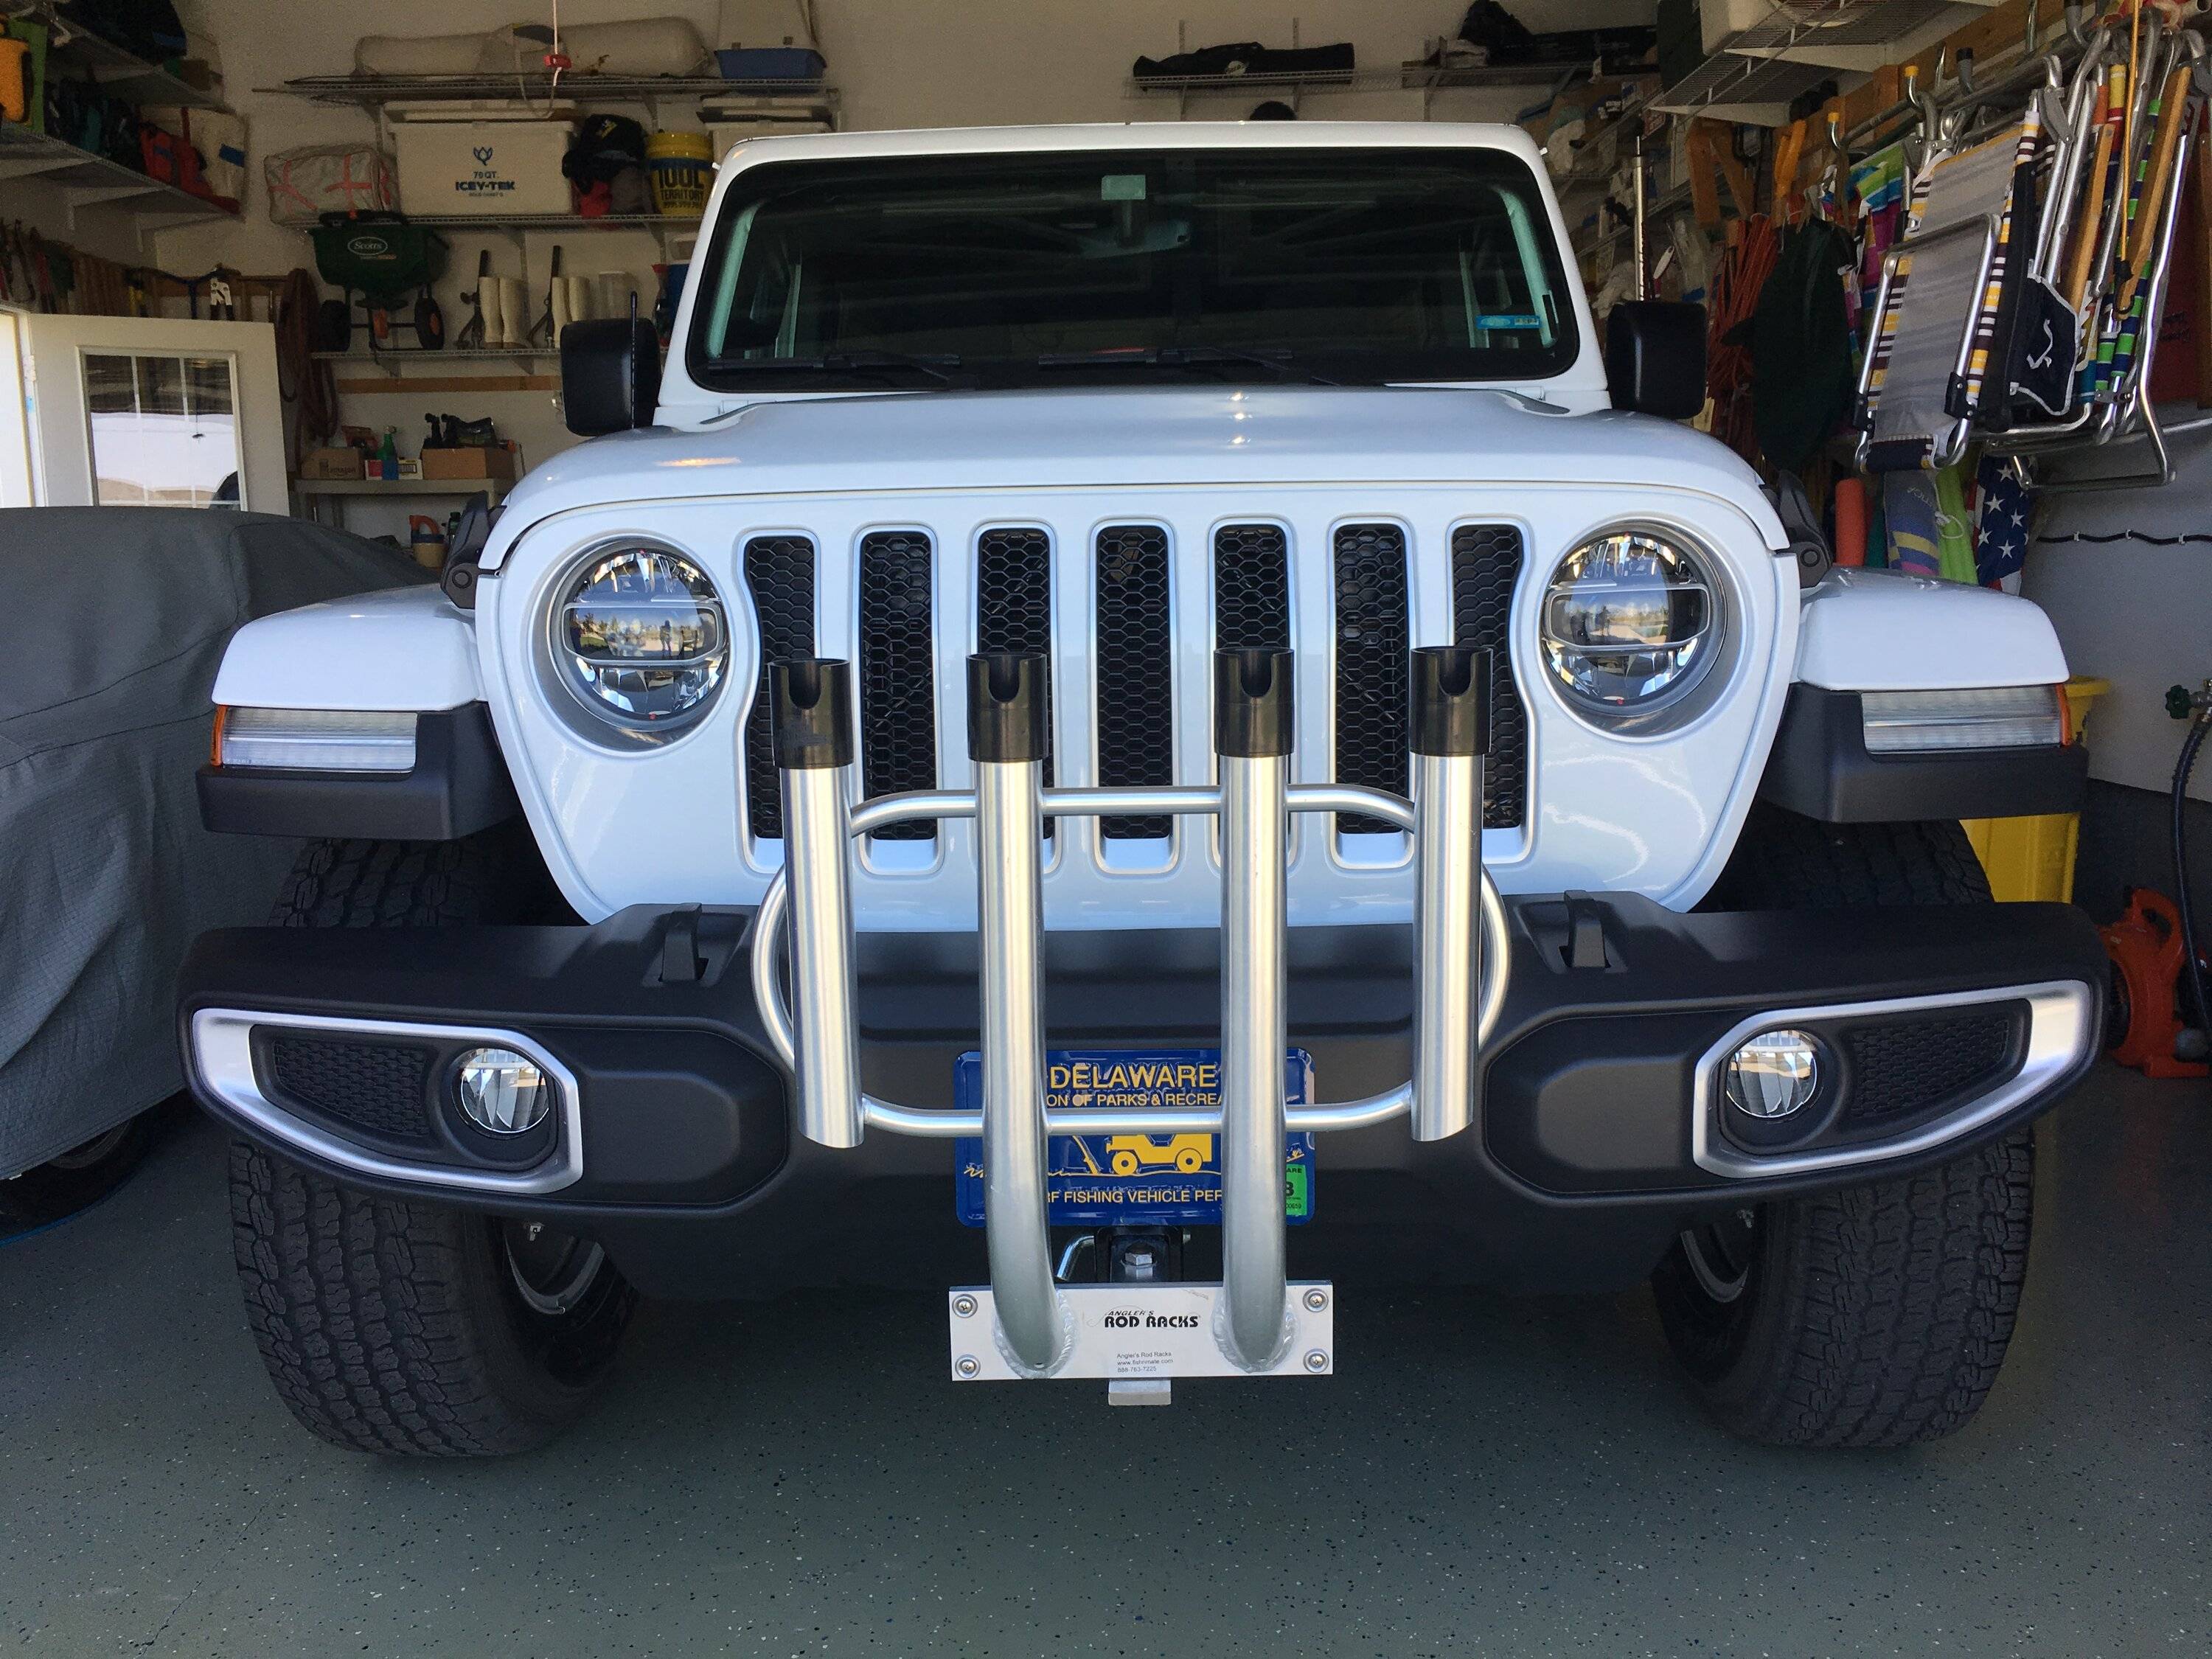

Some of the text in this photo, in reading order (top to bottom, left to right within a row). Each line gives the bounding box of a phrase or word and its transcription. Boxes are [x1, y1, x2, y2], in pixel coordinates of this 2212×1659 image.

[1049, 1064, 1217, 1089] DELAWARE
[1072, 1094, 1093, 1106] OF
[1097, 1094, 1148, 1106] PARKS
[1151, 1094, 1161, 1105] &
[1064, 1191, 1123, 1203] FISHING
[1127, 1190, 1190, 1203] VEHICLE
[1105, 1315, 1199, 1328] ROD RACKS
